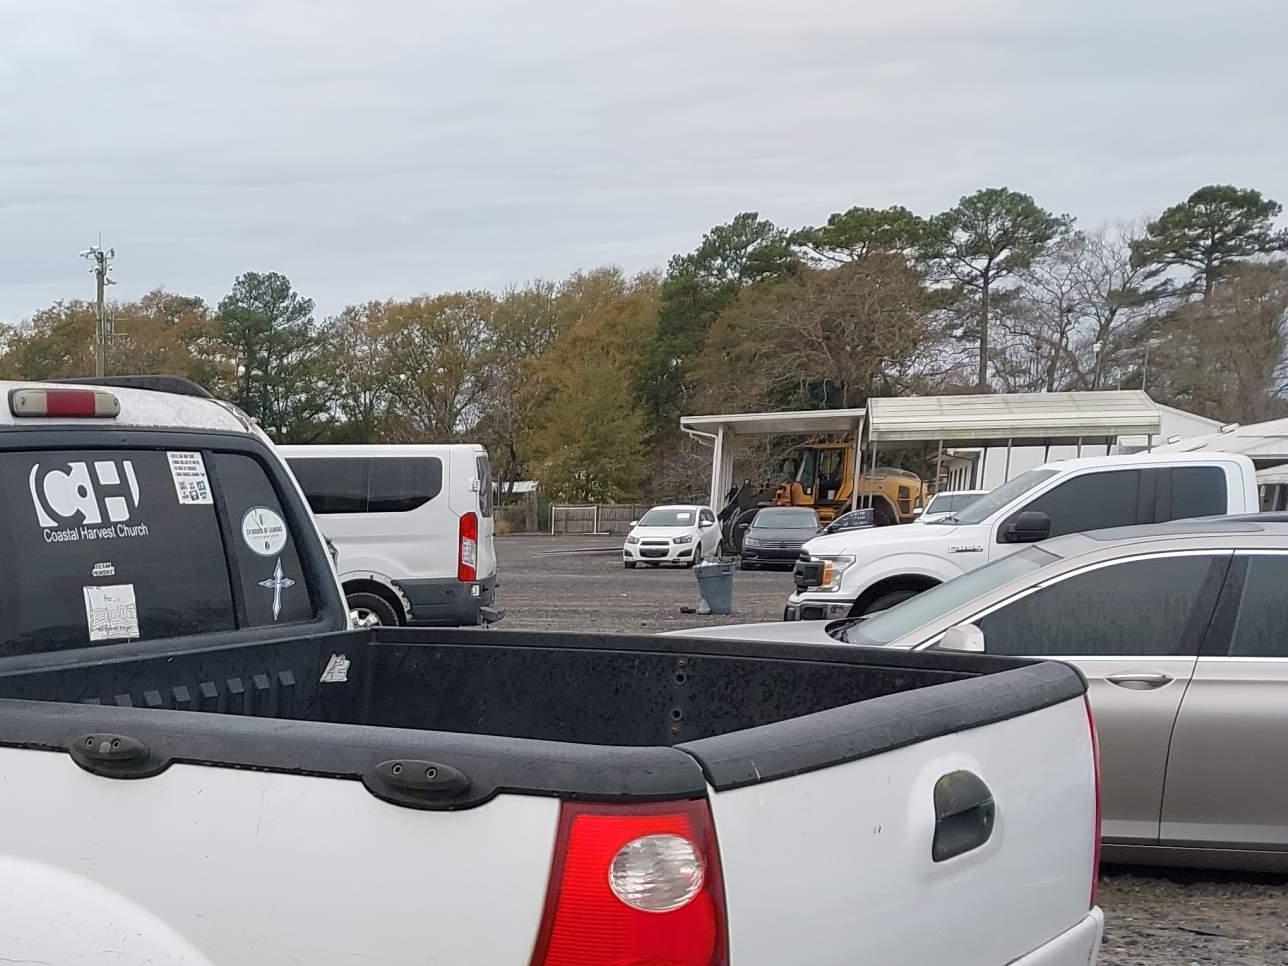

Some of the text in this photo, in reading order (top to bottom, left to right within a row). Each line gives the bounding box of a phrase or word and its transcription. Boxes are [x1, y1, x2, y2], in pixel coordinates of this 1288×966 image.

[43, 522, 149, 543] Coastal Harvest Church
